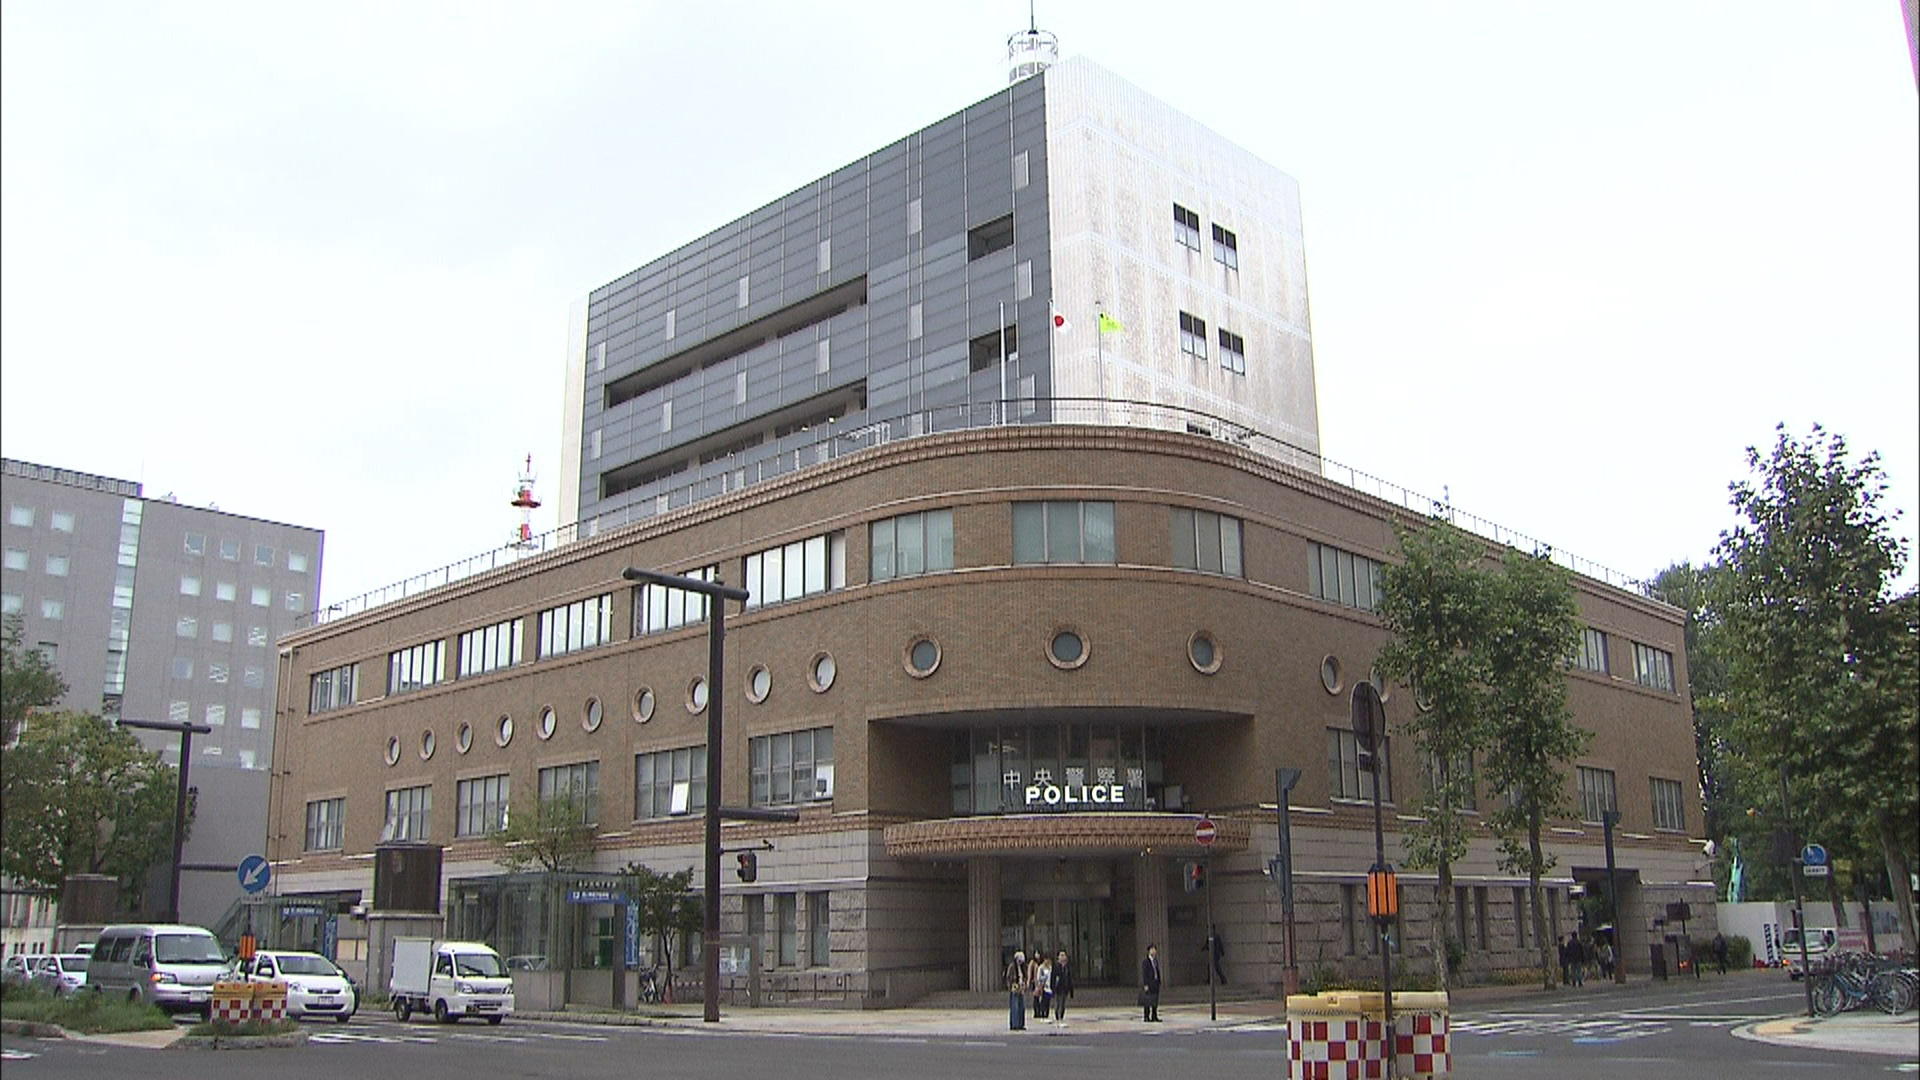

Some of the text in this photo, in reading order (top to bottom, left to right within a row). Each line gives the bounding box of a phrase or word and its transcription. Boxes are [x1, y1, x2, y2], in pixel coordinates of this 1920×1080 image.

[1003, 767, 1143, 790] 中央警察署
[1025, 785, 1125, 804] POLICE
